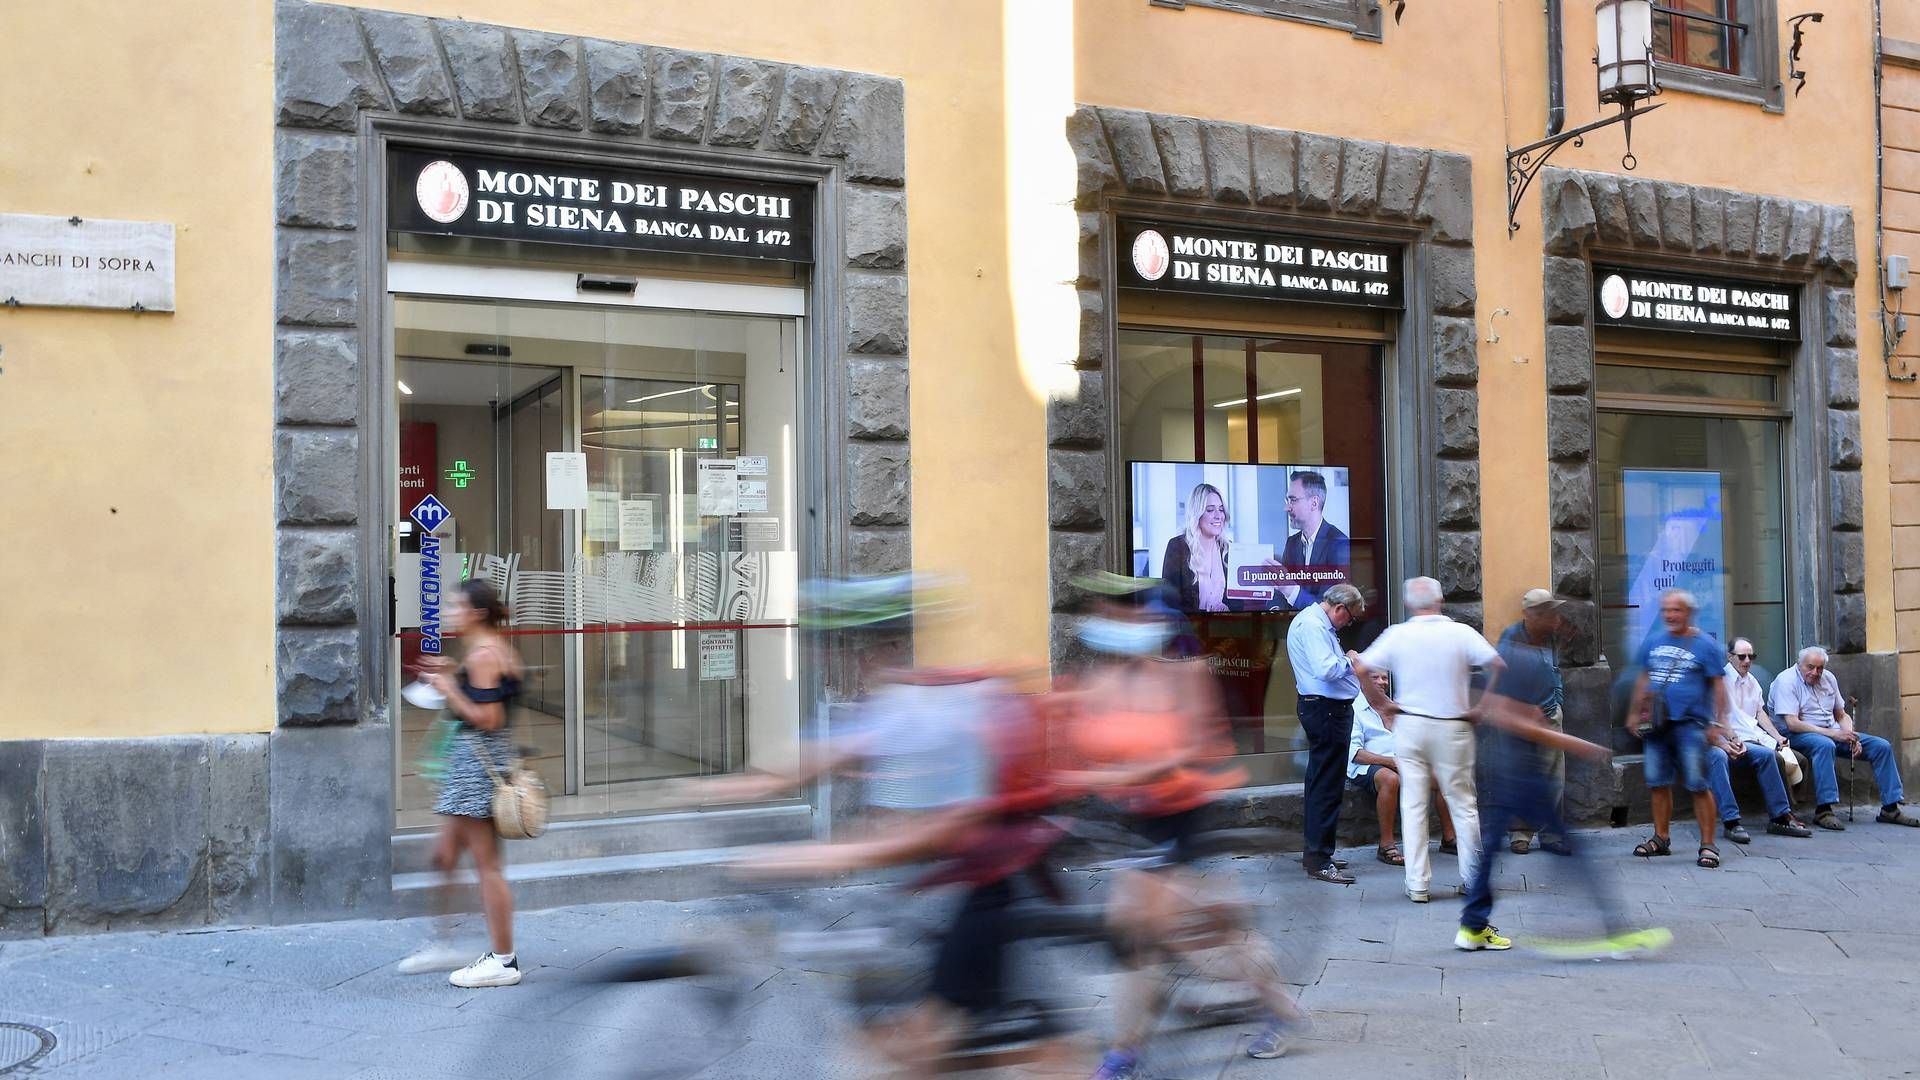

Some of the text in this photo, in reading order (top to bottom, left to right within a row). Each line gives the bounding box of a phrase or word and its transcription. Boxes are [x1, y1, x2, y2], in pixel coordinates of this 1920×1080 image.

[477, 170, 791, 218] MONTE DEI PASCHI
[477, 200, 791, 246] DI SIENA BANCA DAL 1472
[0, 253, 155, 272] ANCHI DI SOPRA
[1173, 236, 1388, 272] MONTE DEI PASCHI
[1174, 261, 1389, 295] DI SIENA BANCA DAL 1472
[1631, 280, 1790, 310] MONTE DEI PASCHI
[1631, 301, 1790, 330] DI SIENA BANCA DAL 1472
[1243, 570, 1346, 583] Il punto è anche quando.
[1662, 559, 1715, 574] Proteggiti
[420, 531, 441, 654] BANCOMAT
[1653, 575, 1675, 590] qui!
